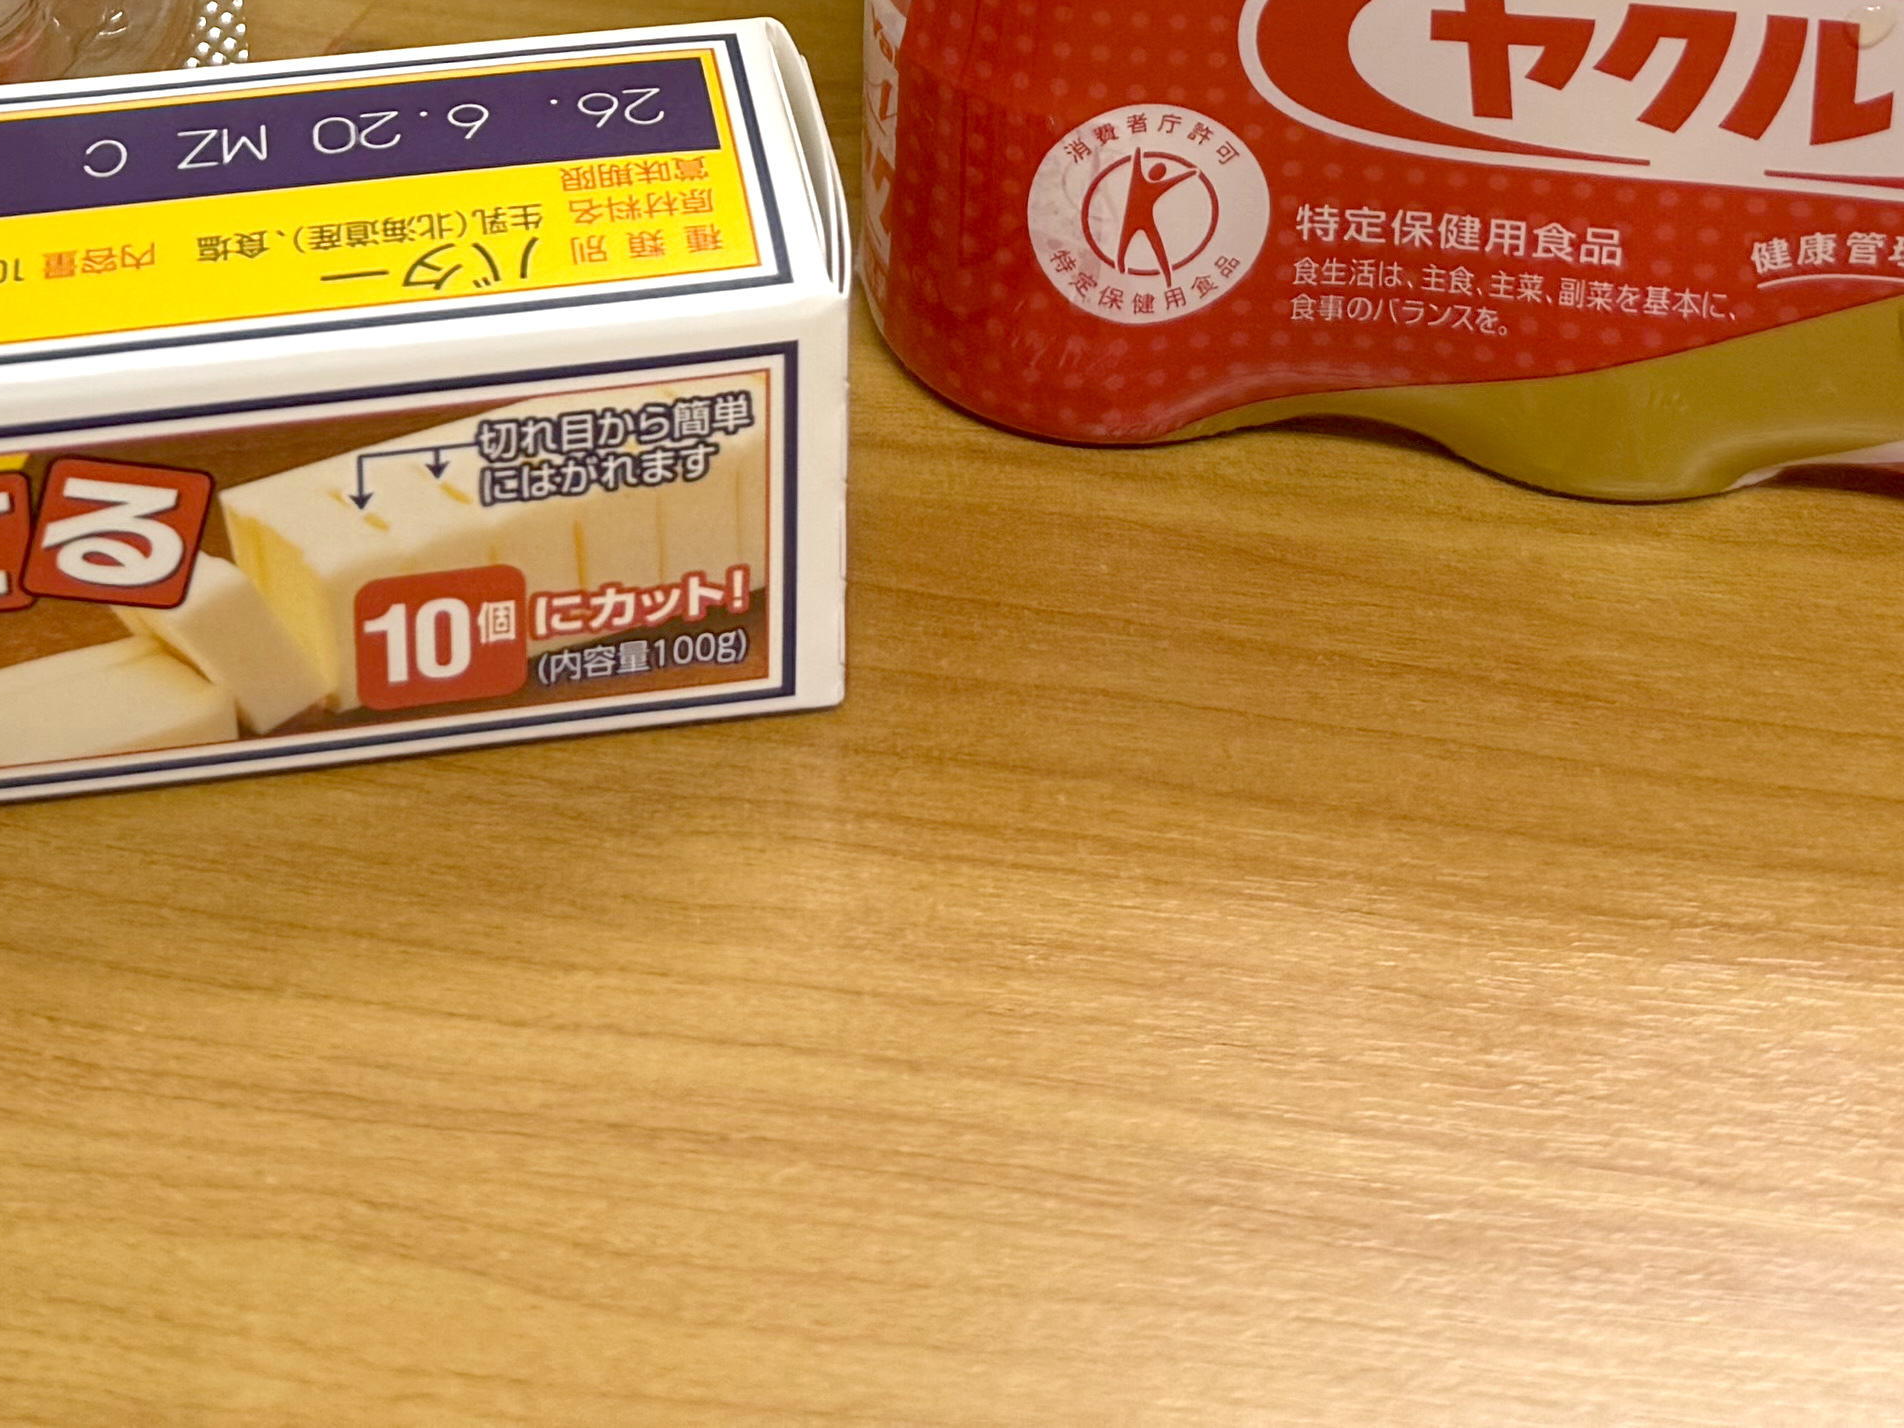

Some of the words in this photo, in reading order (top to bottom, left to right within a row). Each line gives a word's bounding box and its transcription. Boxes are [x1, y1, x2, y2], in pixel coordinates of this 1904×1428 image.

[80, 137, 130, 179] C
[172, 123, 272, 169] MZ
[1064, 112, 1241, 167] 消費者庁許可
[557, 154, 713, 192] 賞味期限
[565, 185, 720, 225] 原材料名
[42, 242, 157, 279] 内容量
[1295, 203, 1624, 269] 特定保健用食品
[315, 235, 550, 301] バター
[1049, 248, 1241, 315] 特定保健用食品
[1291, 256, 1739, 325] 食生活は、主食、主菜、副菜を基本に、
[1289, 292, 1509, 338] 食事のバランスを。
[479, 391, 753, 460] 切れ目から簡単
[481, 442, 718, 507] にはがれます
